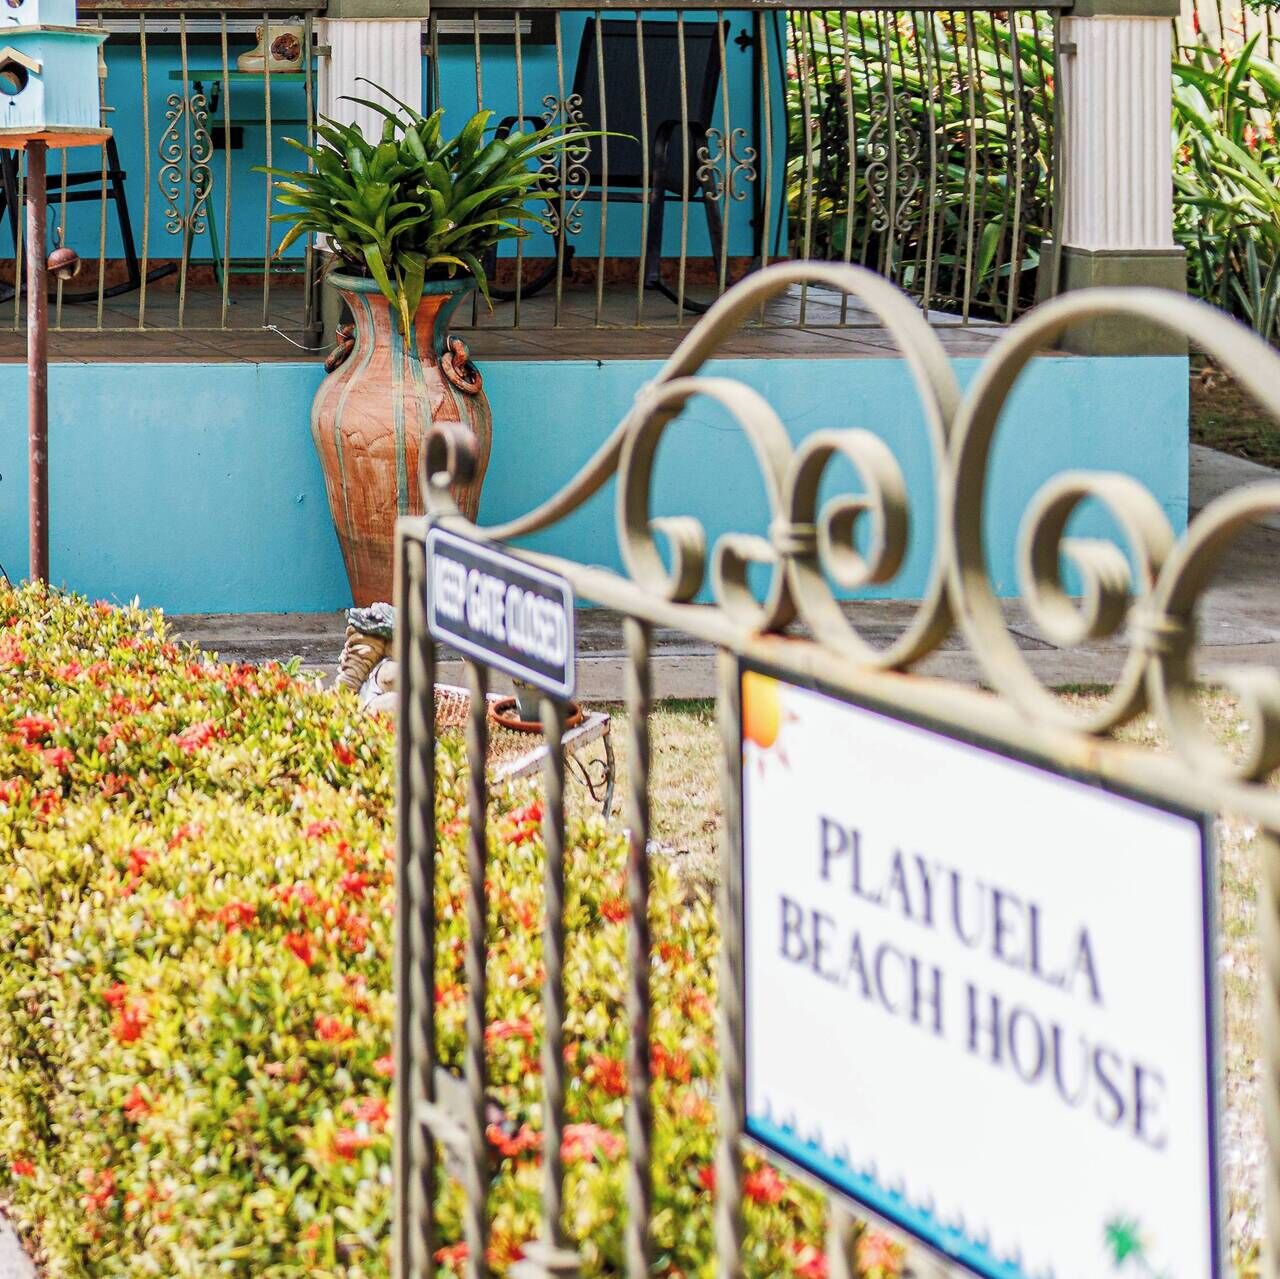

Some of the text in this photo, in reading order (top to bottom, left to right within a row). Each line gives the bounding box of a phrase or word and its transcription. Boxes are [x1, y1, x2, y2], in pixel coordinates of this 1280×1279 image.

[777, 893, 1171, 1152] BEACH HOUSE
[816, 814, 1104, 1007] PLAYUELA
